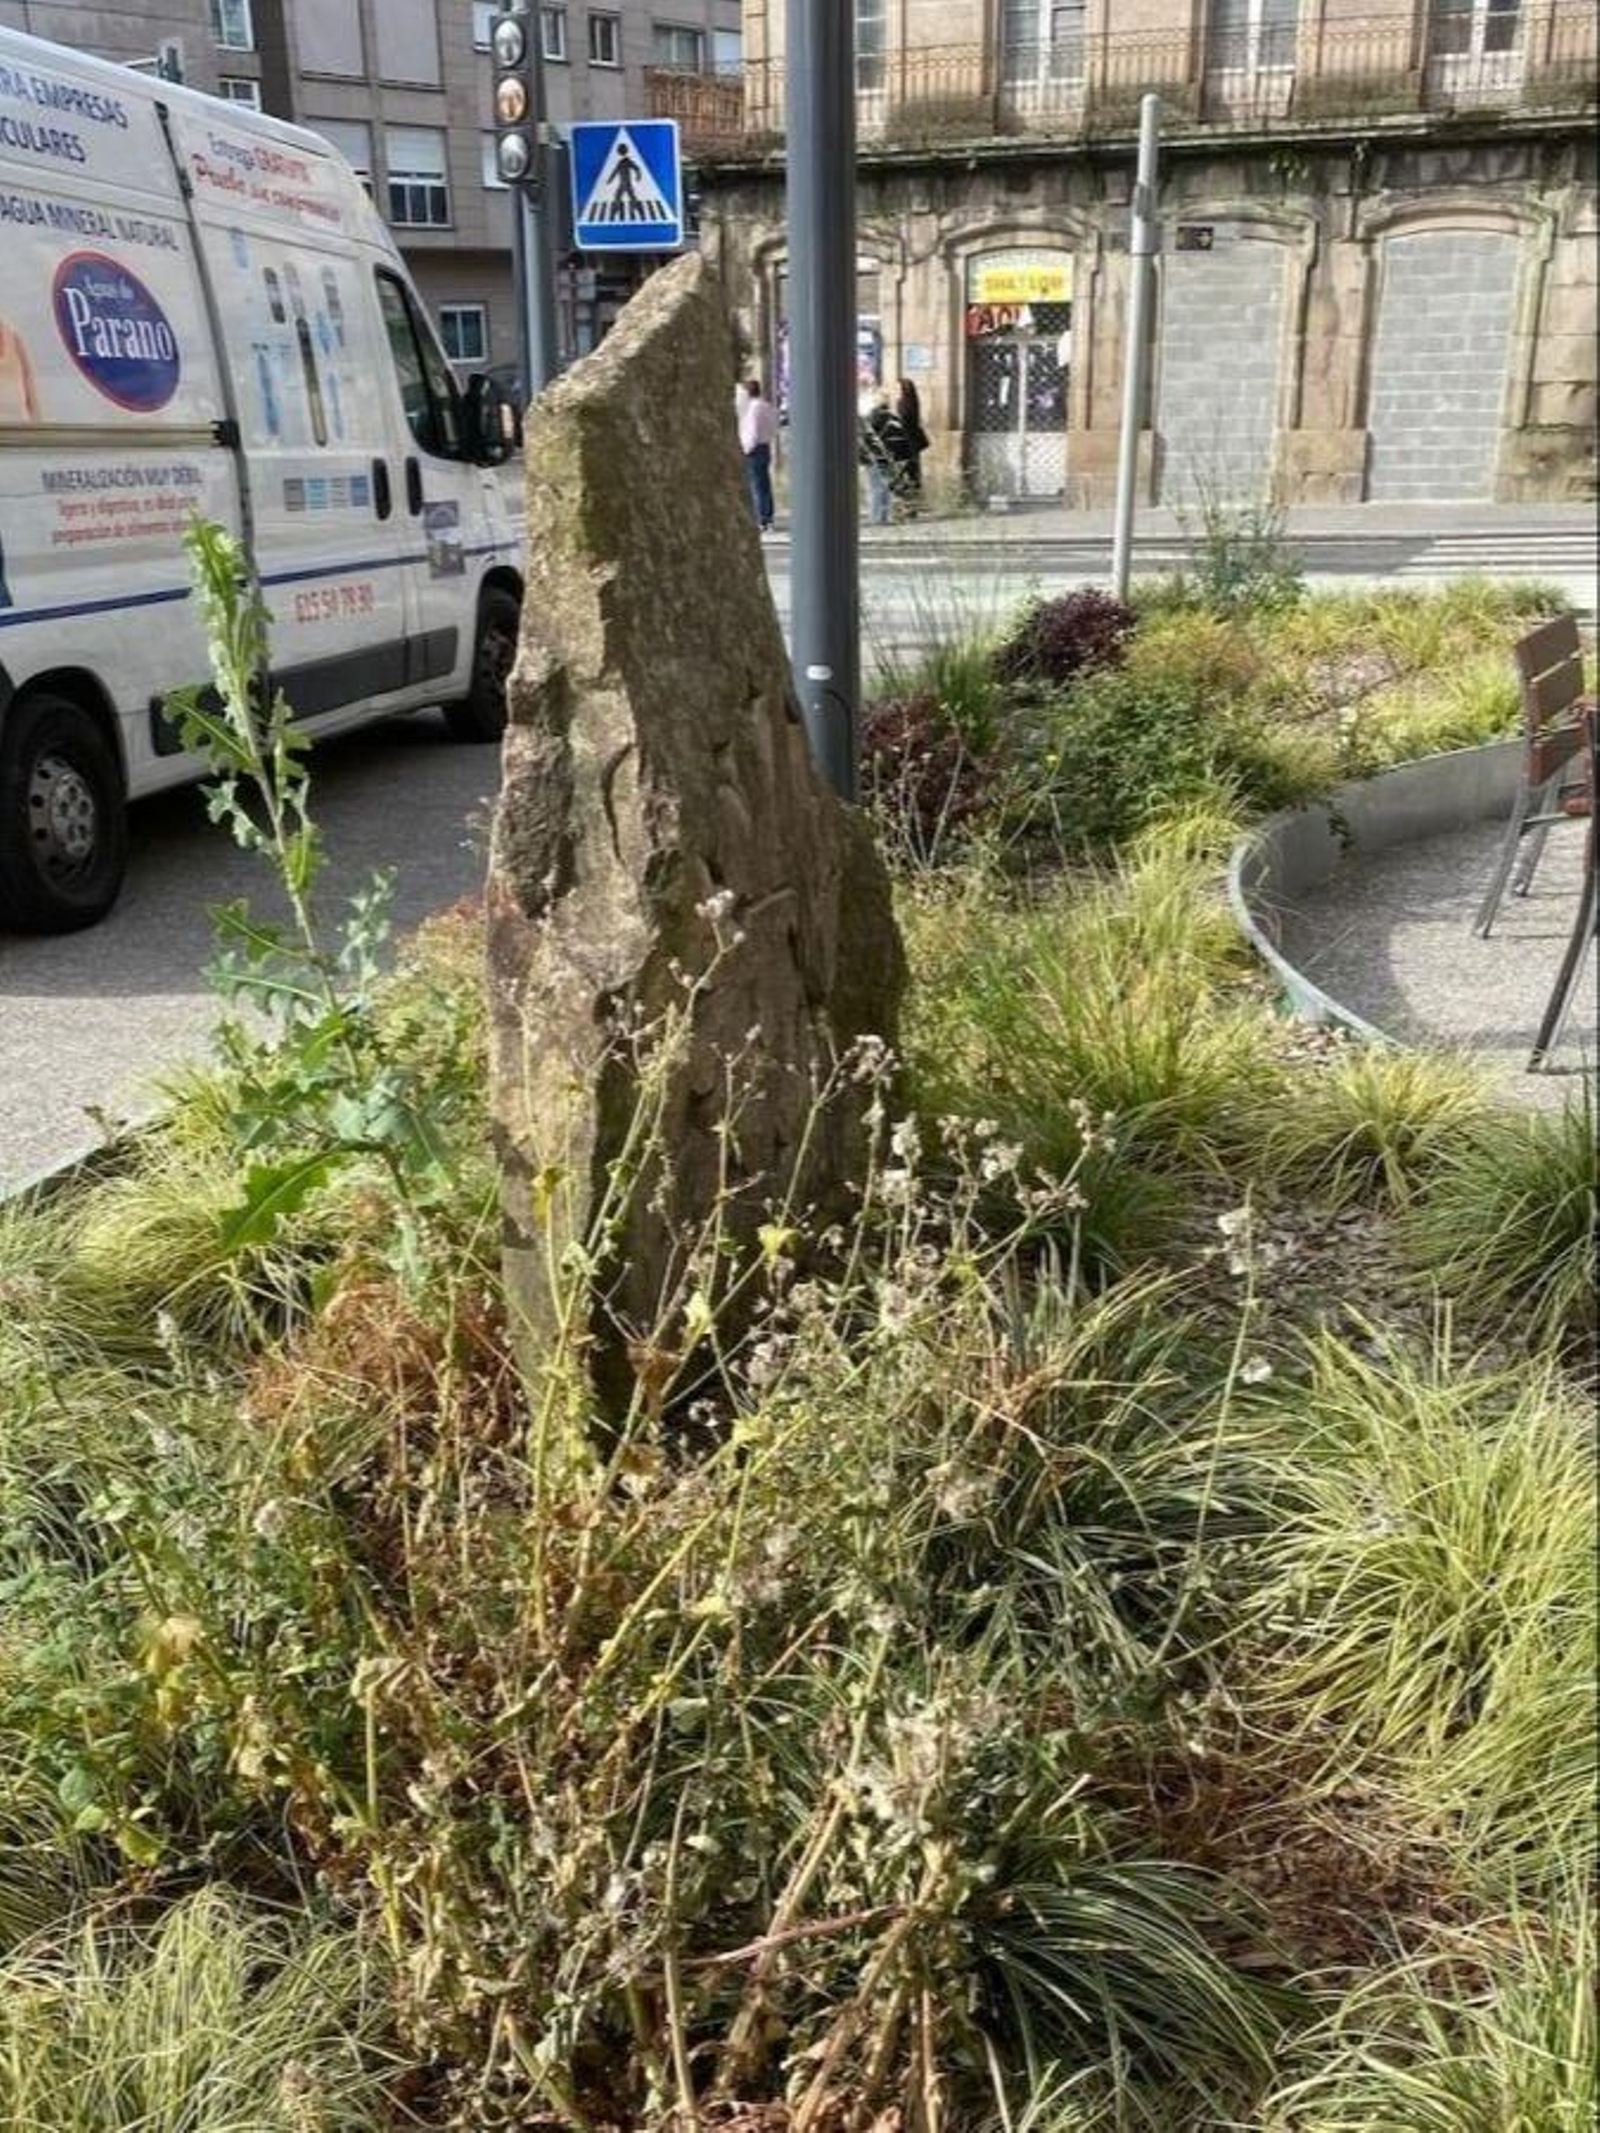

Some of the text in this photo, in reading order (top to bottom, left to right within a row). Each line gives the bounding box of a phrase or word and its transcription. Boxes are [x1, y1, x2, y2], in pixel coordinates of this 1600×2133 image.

[30, 76, 128, 129] EMPRESAS
[0, 193, 180, 251] AGUA MINERAL NATURAL
[63, 287, 175, 361] Parano
[40, 464, 144, 493] MINERALIZACIÓN
[144, 466, 170, 487] MUY
